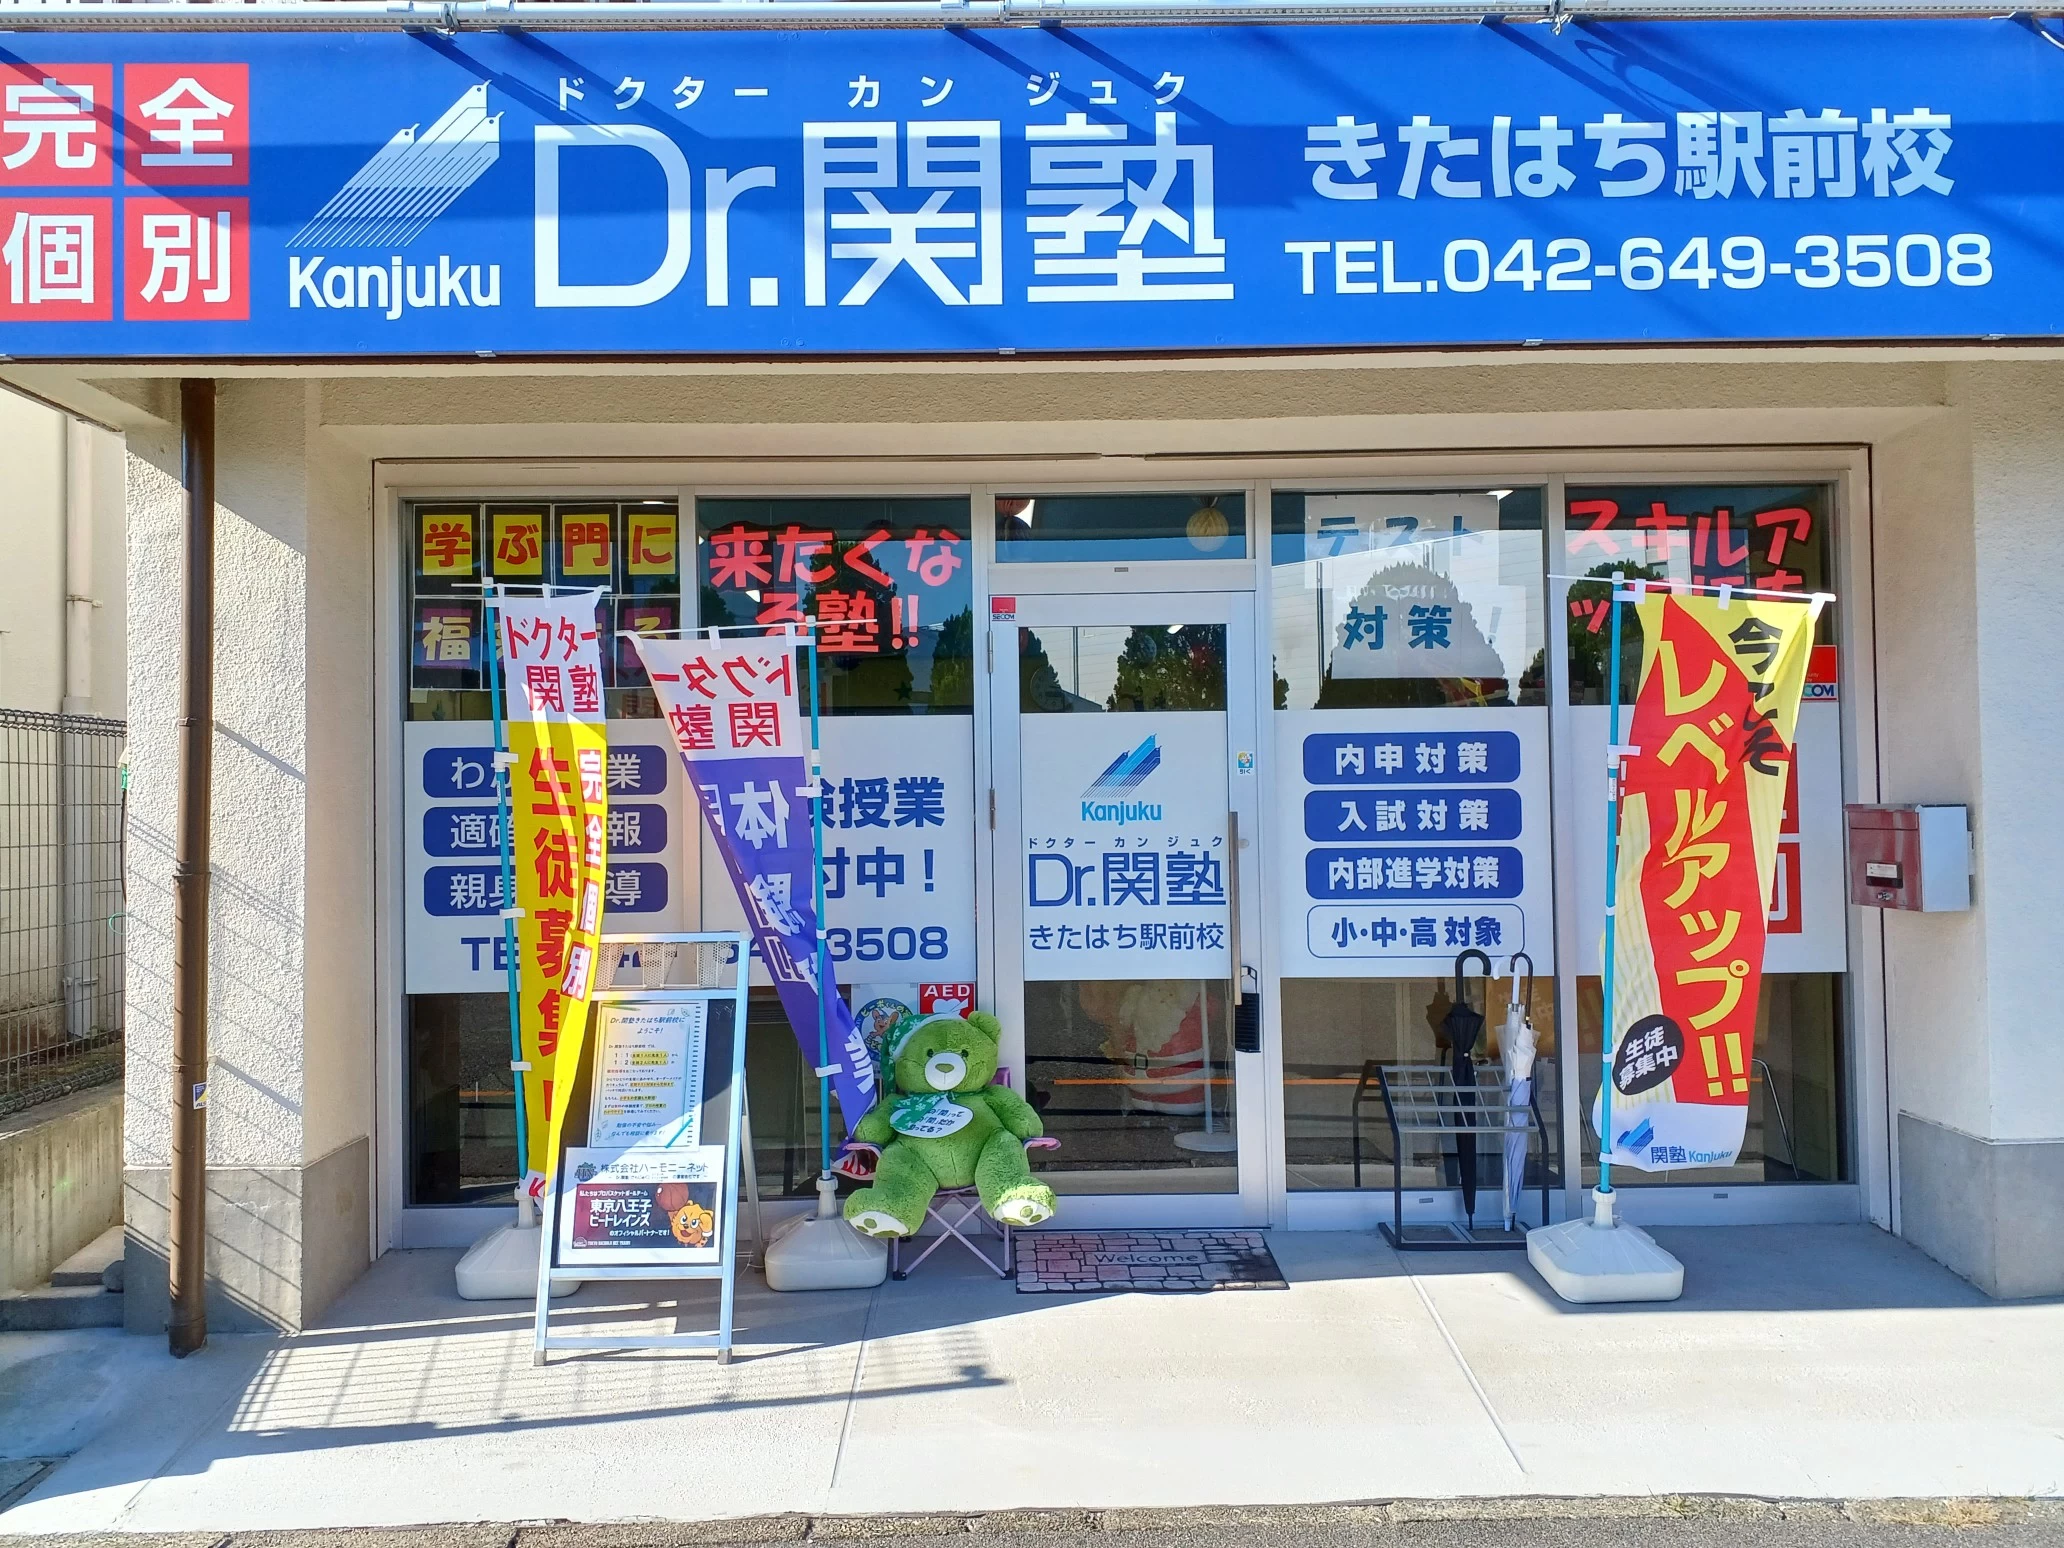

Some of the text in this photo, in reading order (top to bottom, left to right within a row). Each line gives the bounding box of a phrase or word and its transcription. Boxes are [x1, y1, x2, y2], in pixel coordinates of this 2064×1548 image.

[558, 75, 769, 111] ドクター
[2, 77, 236, 170] 完全
[1303, 107, 1956, 201] きたはち駅前校
[534, 111, 1234, 307] Dr.関塾
[2, 210, 232, 304] 個別
[1284, 233, 1994, 295] TEL.042-649-3508
[288, 255, 501, 321] Kanjuku
[424, 522, 674, 568] 学ぶ門に
[708, 525, 963, 588] 来たくな
[1316, 514, 1484, 561] テスト
[504, 615, 598, 661] ドクター
[526, 663, 600, 713] 関塾
[1803, 684, 1835, 698] COM
[1335, 741, 1489, 776] 内申対策
[1081, 801, 1162, 826] Kanjuku
[1337, 798, 1489, 832] 入試対策
[1029, 837, 1096, 849] ドクター
[1028, 850, 1227, 907] Dr.関塾
[1328, 855, 1500, 890] 内部進学対策
[1029, 922, 1225, 950] きたはち駅前校
[924, 984, 971, 998] AED
[1625, 1025, 1665, 1063] 生徒
[1619, 1045, 1678, 1090] 募集中
[1651, 1145, 1733, 1164] 関塾 Kanjuku
[589, 1212, 651, 1227] ビートレインズ
[590, 1198, 652, 1213] 東京八王子
[1094, 1253, 1199, 1264] Welcome
